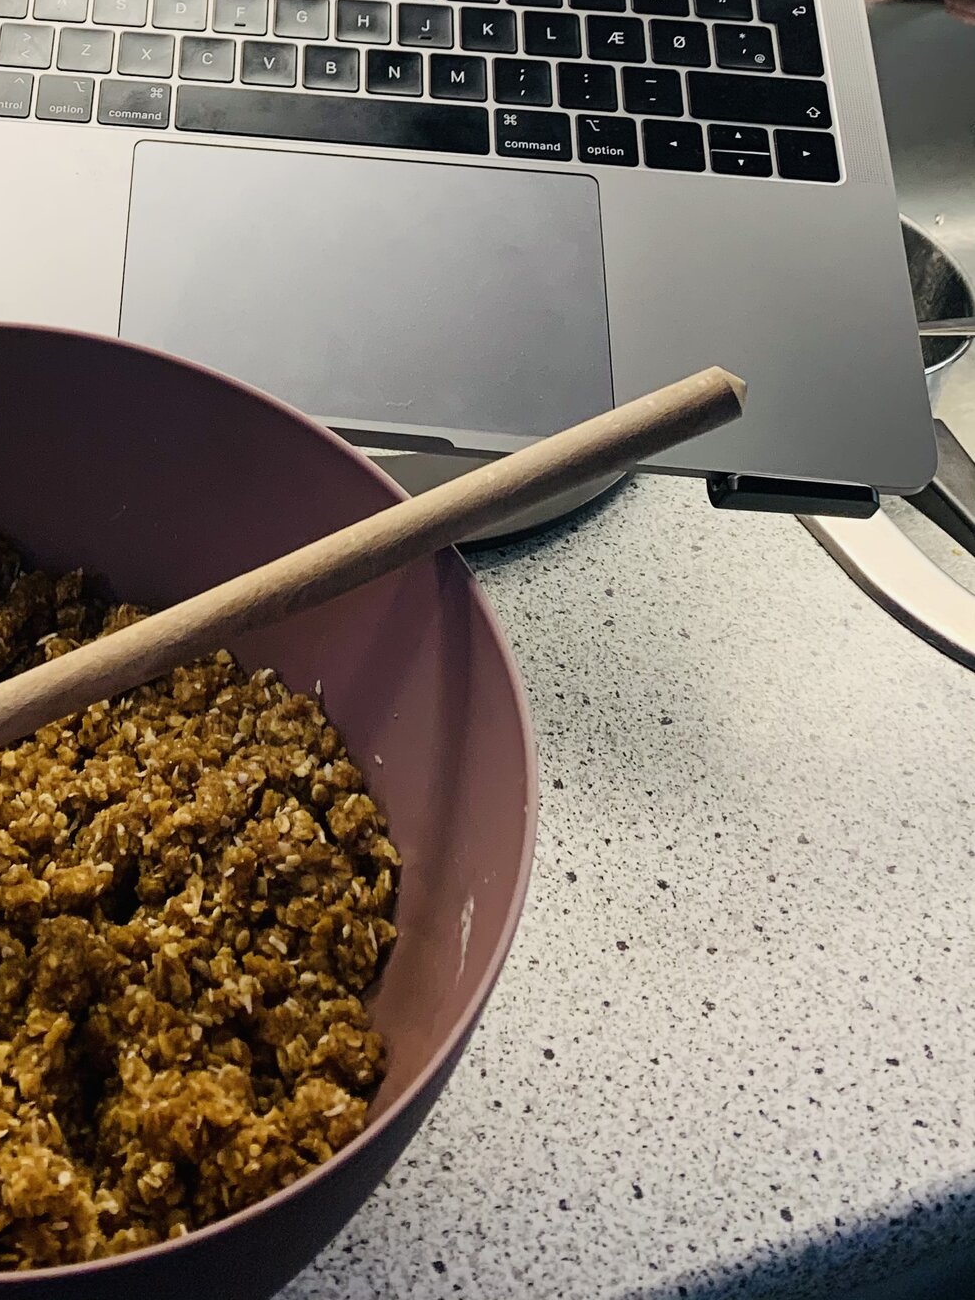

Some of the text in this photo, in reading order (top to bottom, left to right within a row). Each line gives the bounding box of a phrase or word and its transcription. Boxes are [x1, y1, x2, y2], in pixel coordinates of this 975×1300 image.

[175, 1, 187, 15] D
[236, 6, 246, 19] F
[296, 9, 308, 23] G
[357, 14, 370, 28] H
[420, 19, 431, 33] J
[482, 22, 494, 36] K
[546, 26, 557, 40] L
[606, 31, 625, 45] Æ
[672, 35, 686, 50] Ø
[80, 44, 92, 56] Z
[141, 48, 153, 61] X
[201, 52, 214, 66] C
[263, 56, 275, 70] V
[325, 61, 337, 75] B
[388, 66, 401, 80] N
[450, 70, 465, 84] M
[48, 104, 84, 116] option
[108, 109, 162, 121] command
[504, 139, 561, 152] command
[586, 145, 625, 157] option
